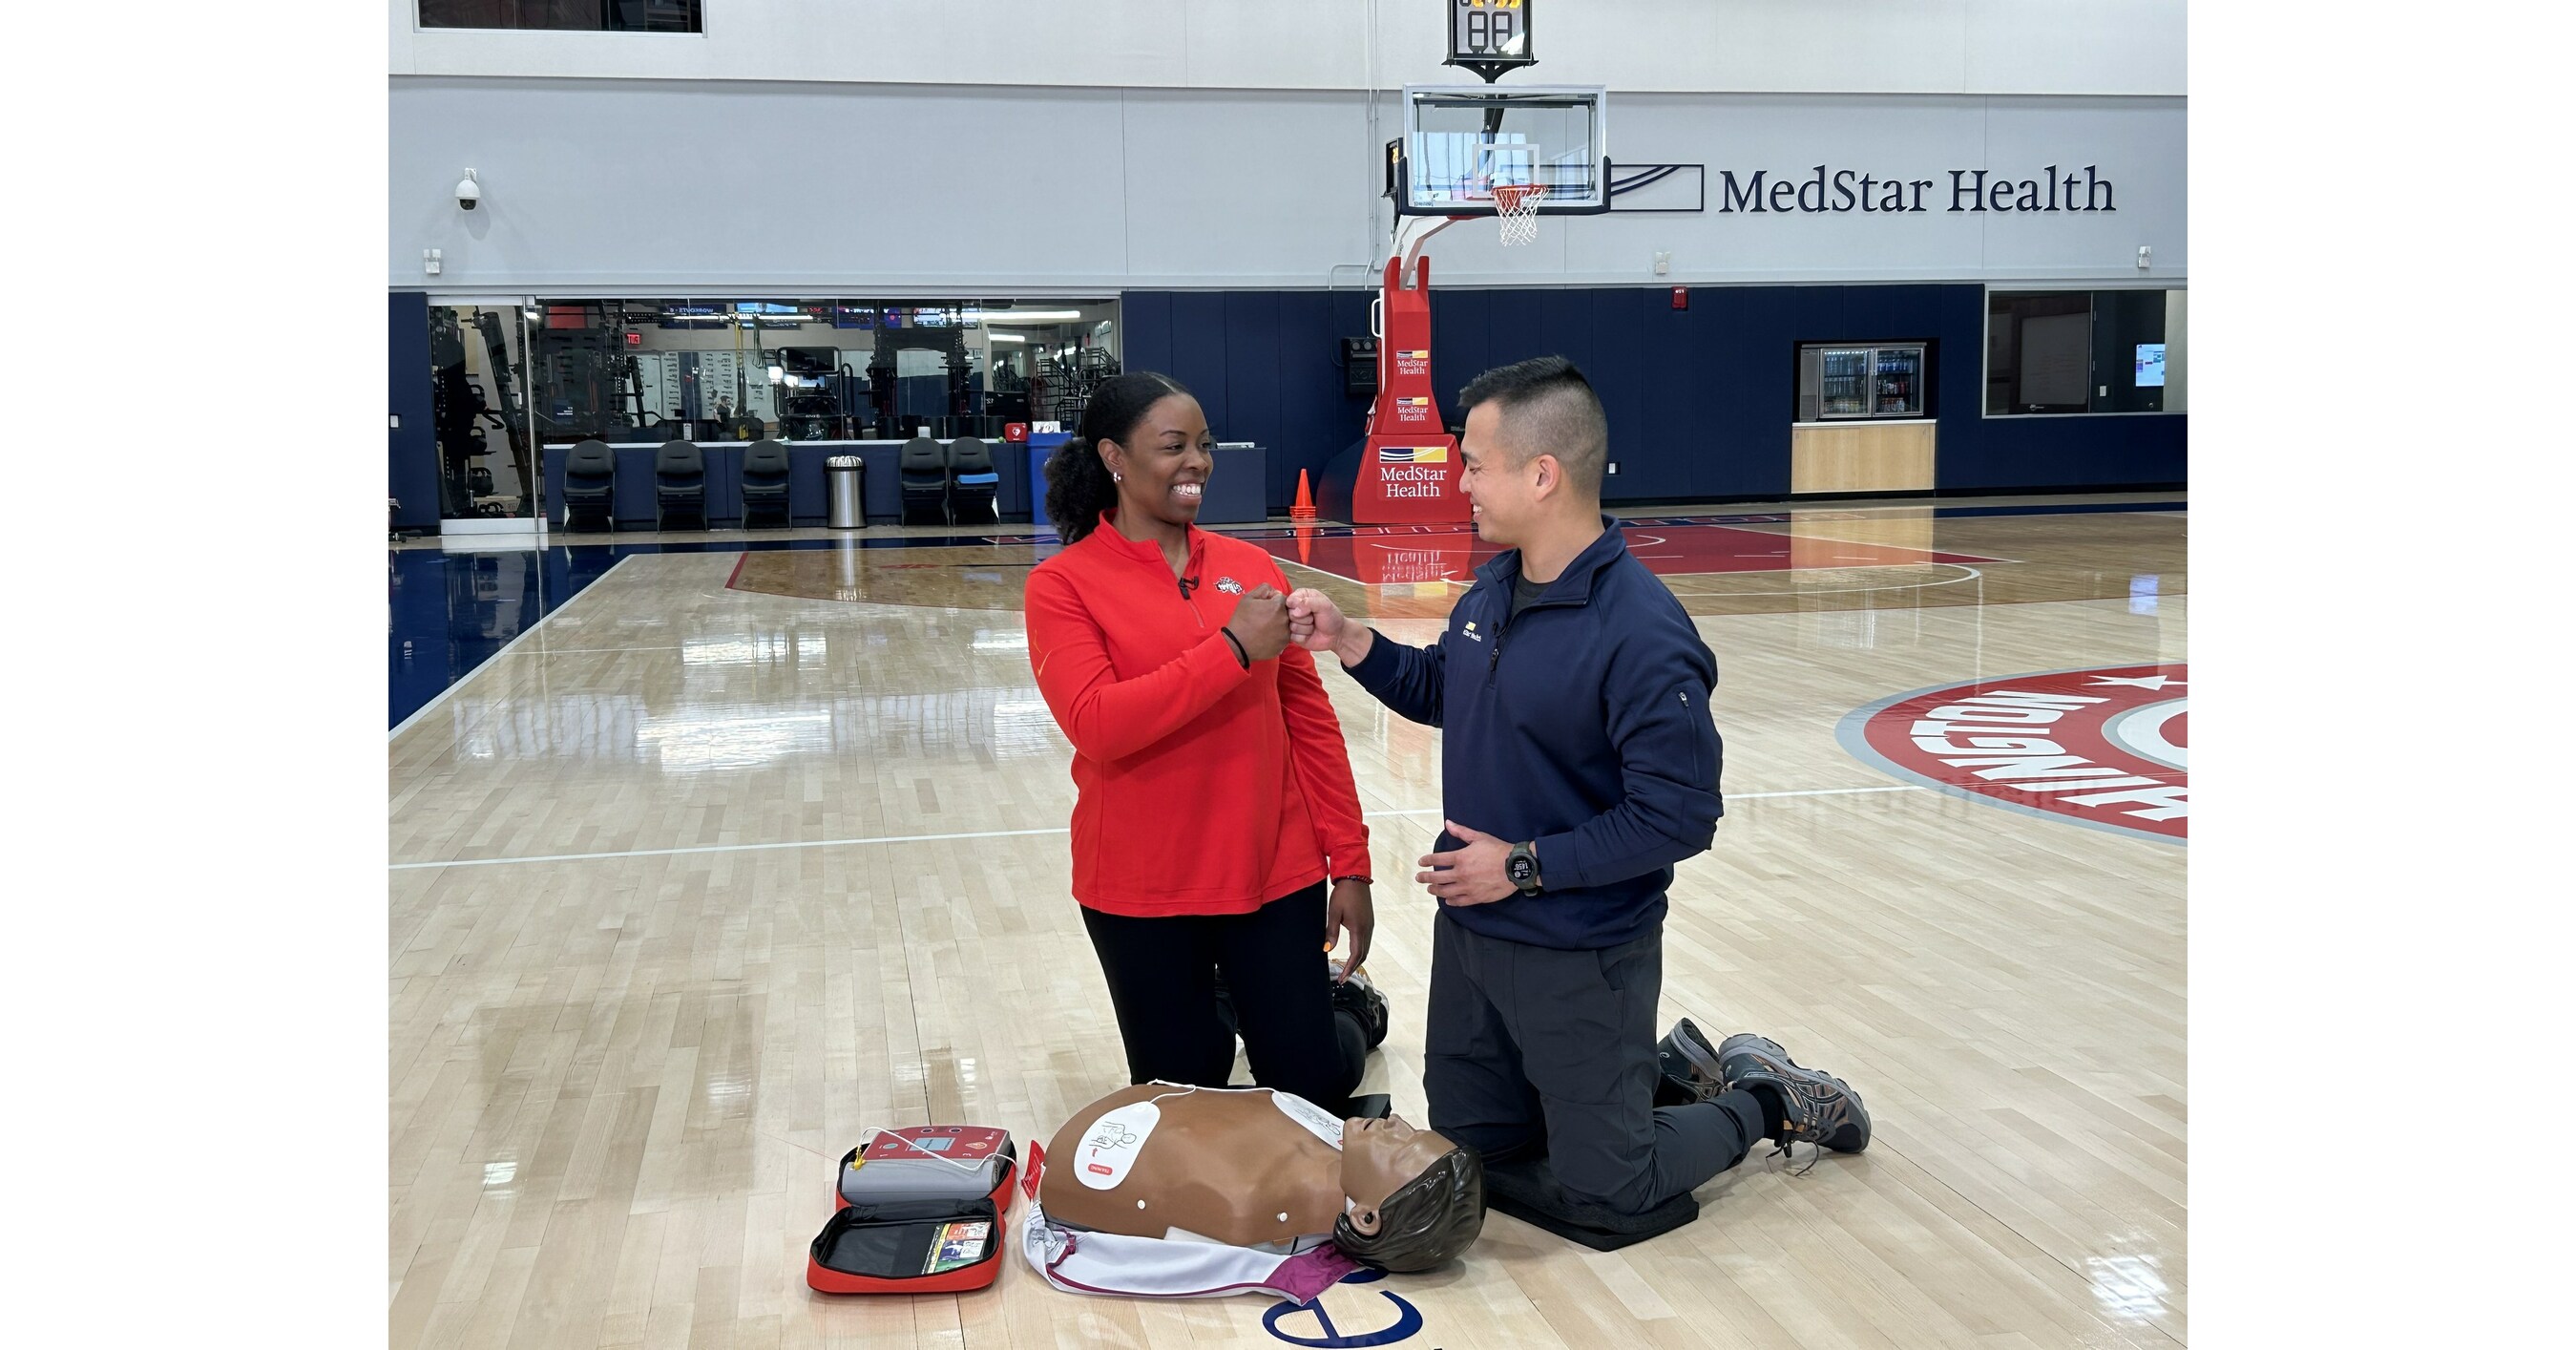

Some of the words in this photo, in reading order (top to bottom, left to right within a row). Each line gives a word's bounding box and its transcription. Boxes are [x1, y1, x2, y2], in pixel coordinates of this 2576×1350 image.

[1719, 165, 1934, 213] MedStar
[1947, 165, 2117, 212] Health
[1400, 367, 1425, 375] Health
[1400, 413, 1426, 422] Health
[1380, 466, 1447, 481] MedStar
[1387, 482, 1441, 497] Health
